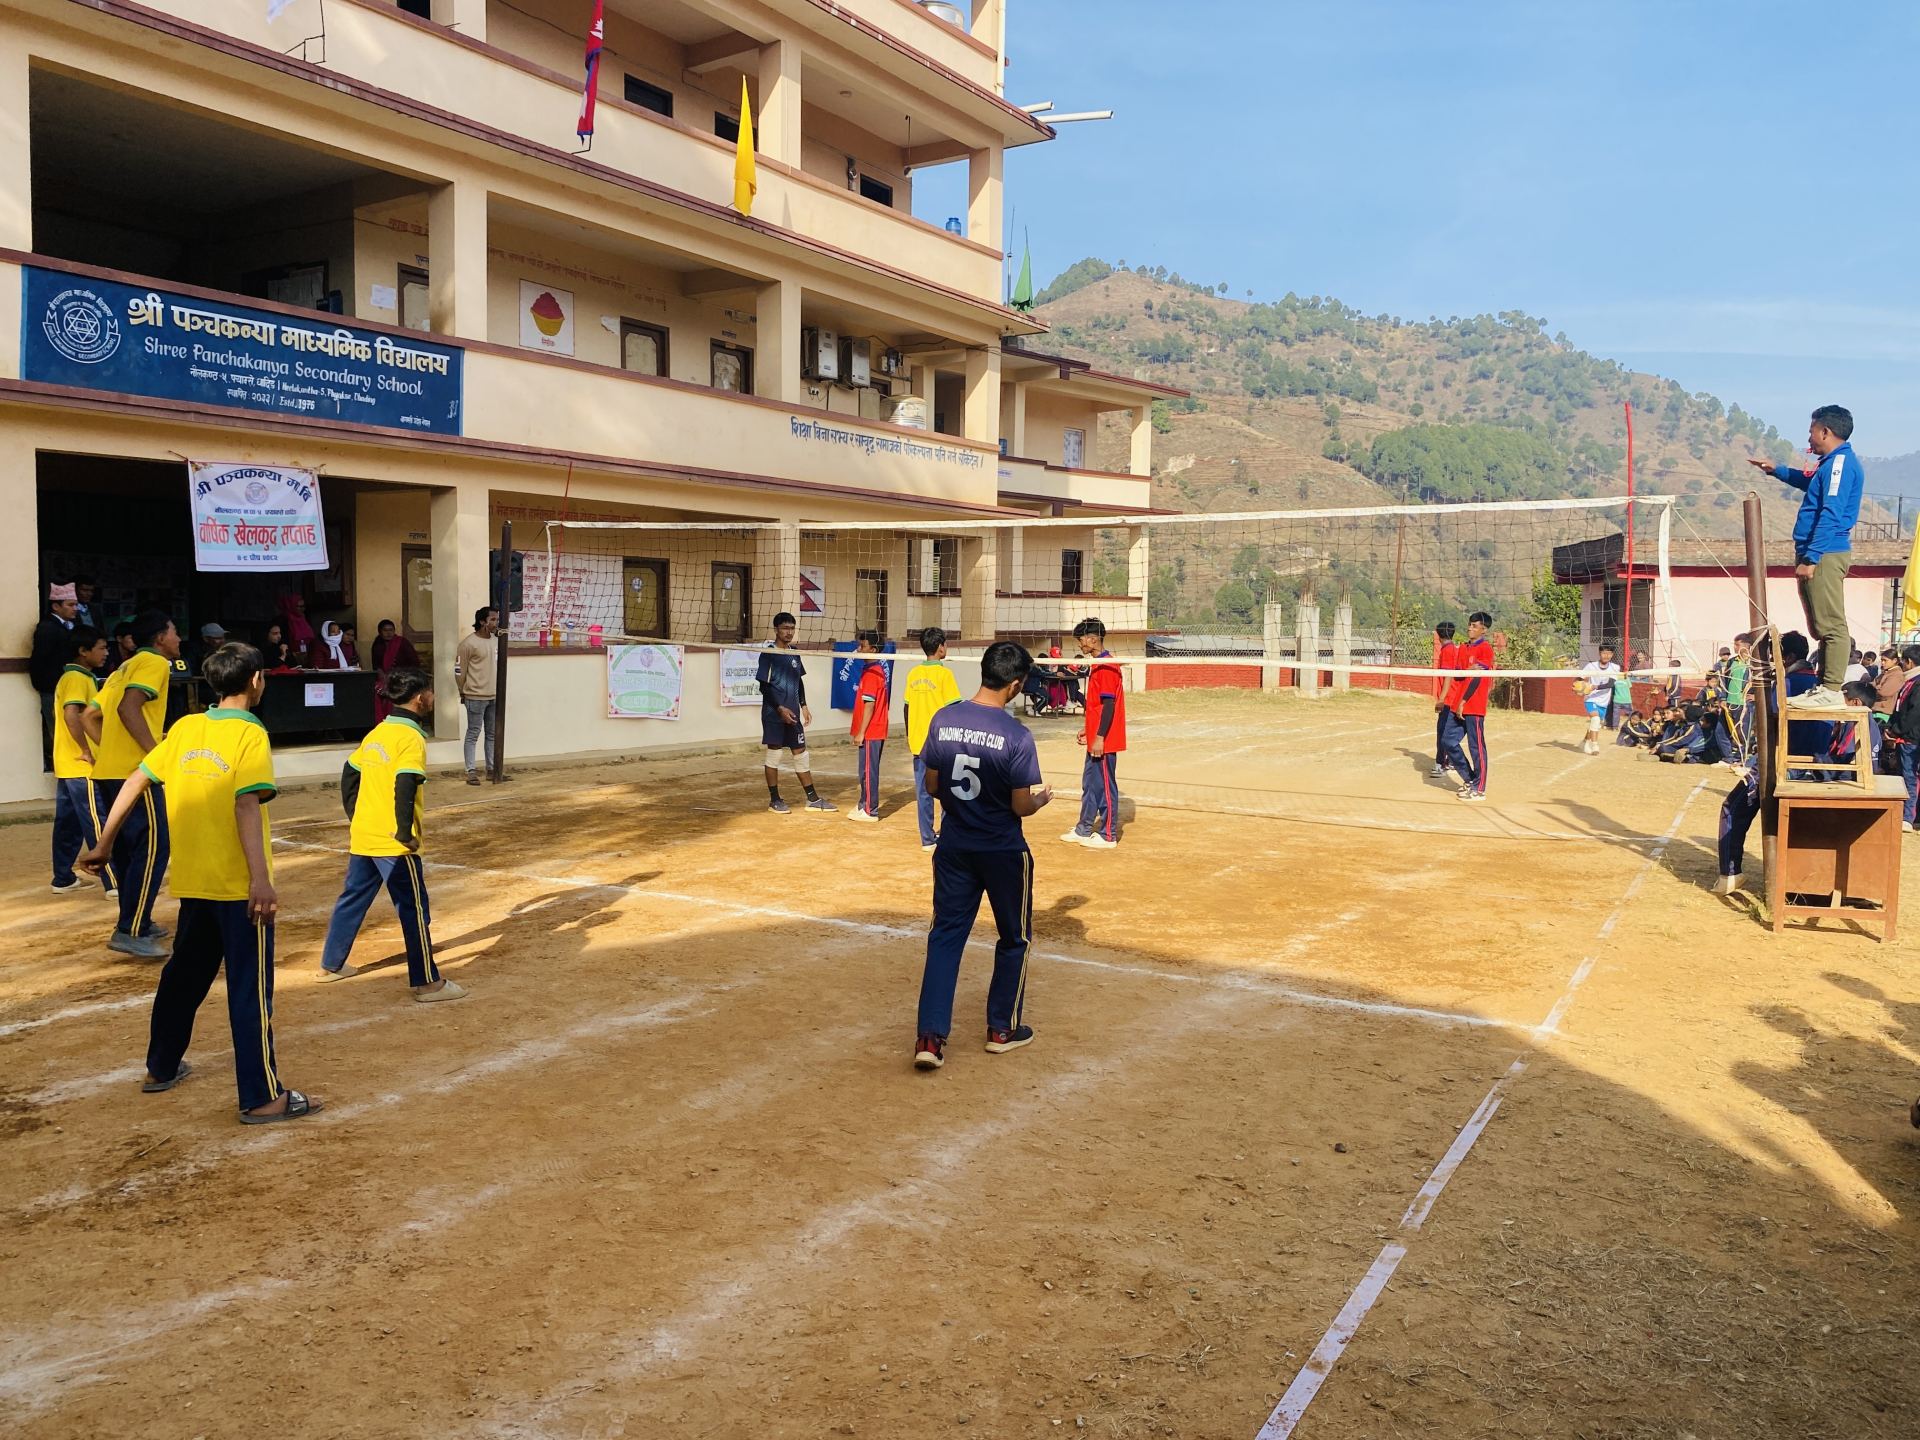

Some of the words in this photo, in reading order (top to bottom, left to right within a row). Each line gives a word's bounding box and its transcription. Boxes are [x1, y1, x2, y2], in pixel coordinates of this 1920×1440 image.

[128, 293, 164, 327] श्री
[170, 305, 277, 346] पञ्चकन्या
[281, 325, 372, 362] माध्यमिक
[374, 336, 450, 376] विद्यालय
[144, 336, 187, 359] Shree
[193, 344, 289, 378] Panchakanya
[295, 361, 371, 392] Secondary
[377, 374, 423, 395] School
[214, 468, 283, 486] पञ्चकन्या
[199, 516, 230, 546] वार्षिक
[234, 518, 278, 552] खेलकुद
[281, 524, 317, 546] सप्ताह
[963, 728, 987, 747] SPORTS
[986, 733, 1005, 751] CLUB
[950, 753, 982, 801] 5
